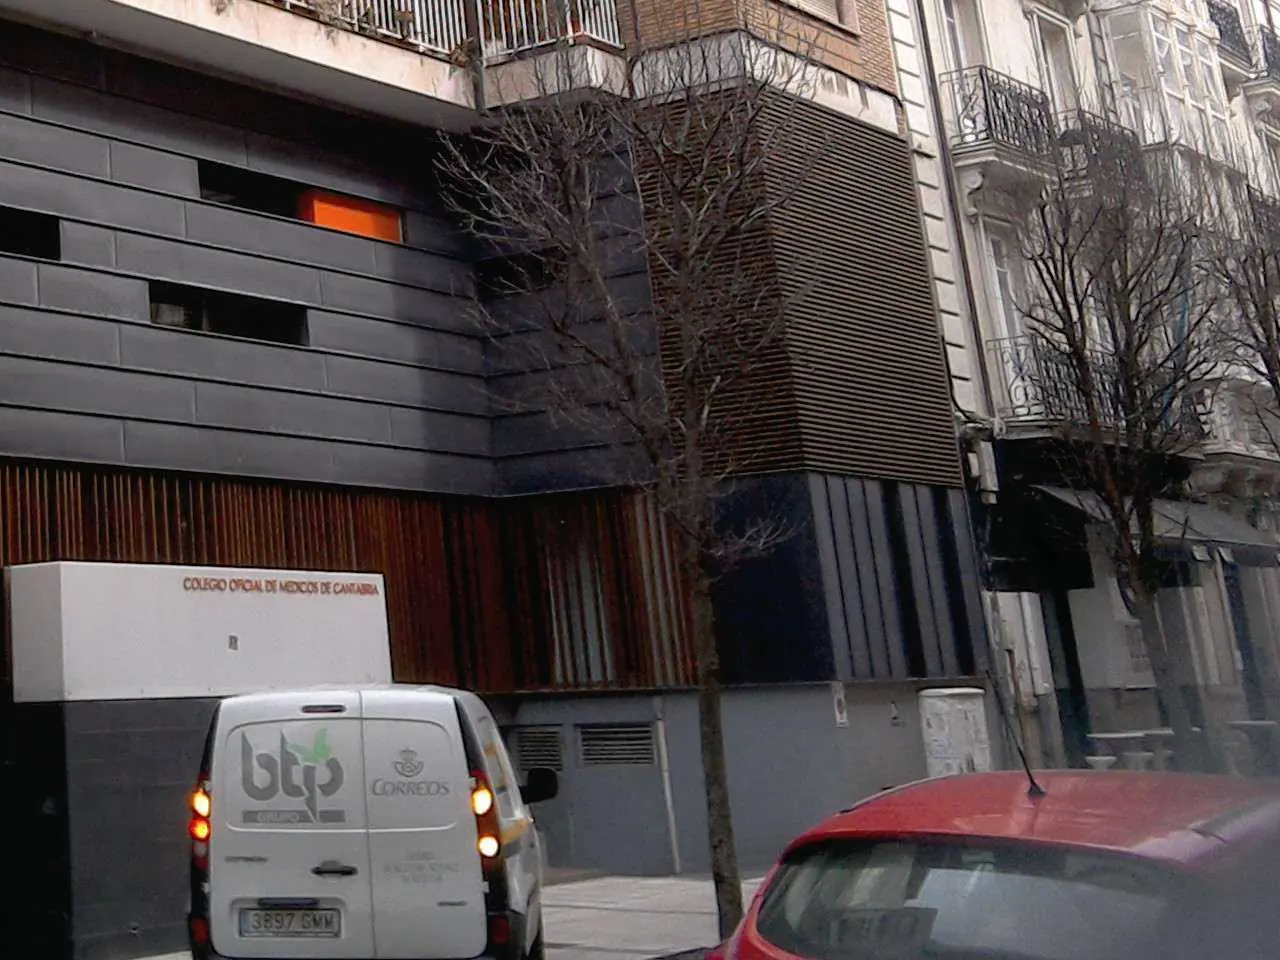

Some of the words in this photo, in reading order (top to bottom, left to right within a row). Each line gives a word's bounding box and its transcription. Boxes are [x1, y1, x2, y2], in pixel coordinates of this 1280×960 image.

[183, 577, 227, 591] COLEGIO
[229, 578, 263, 592] OFICIAL
[265, 579, 278, 593] DE
[320, 581, 333, 595] DE
[333, 582, 379, 596] CANTABRIA
[372, 778, 450, 796] CORREOS
